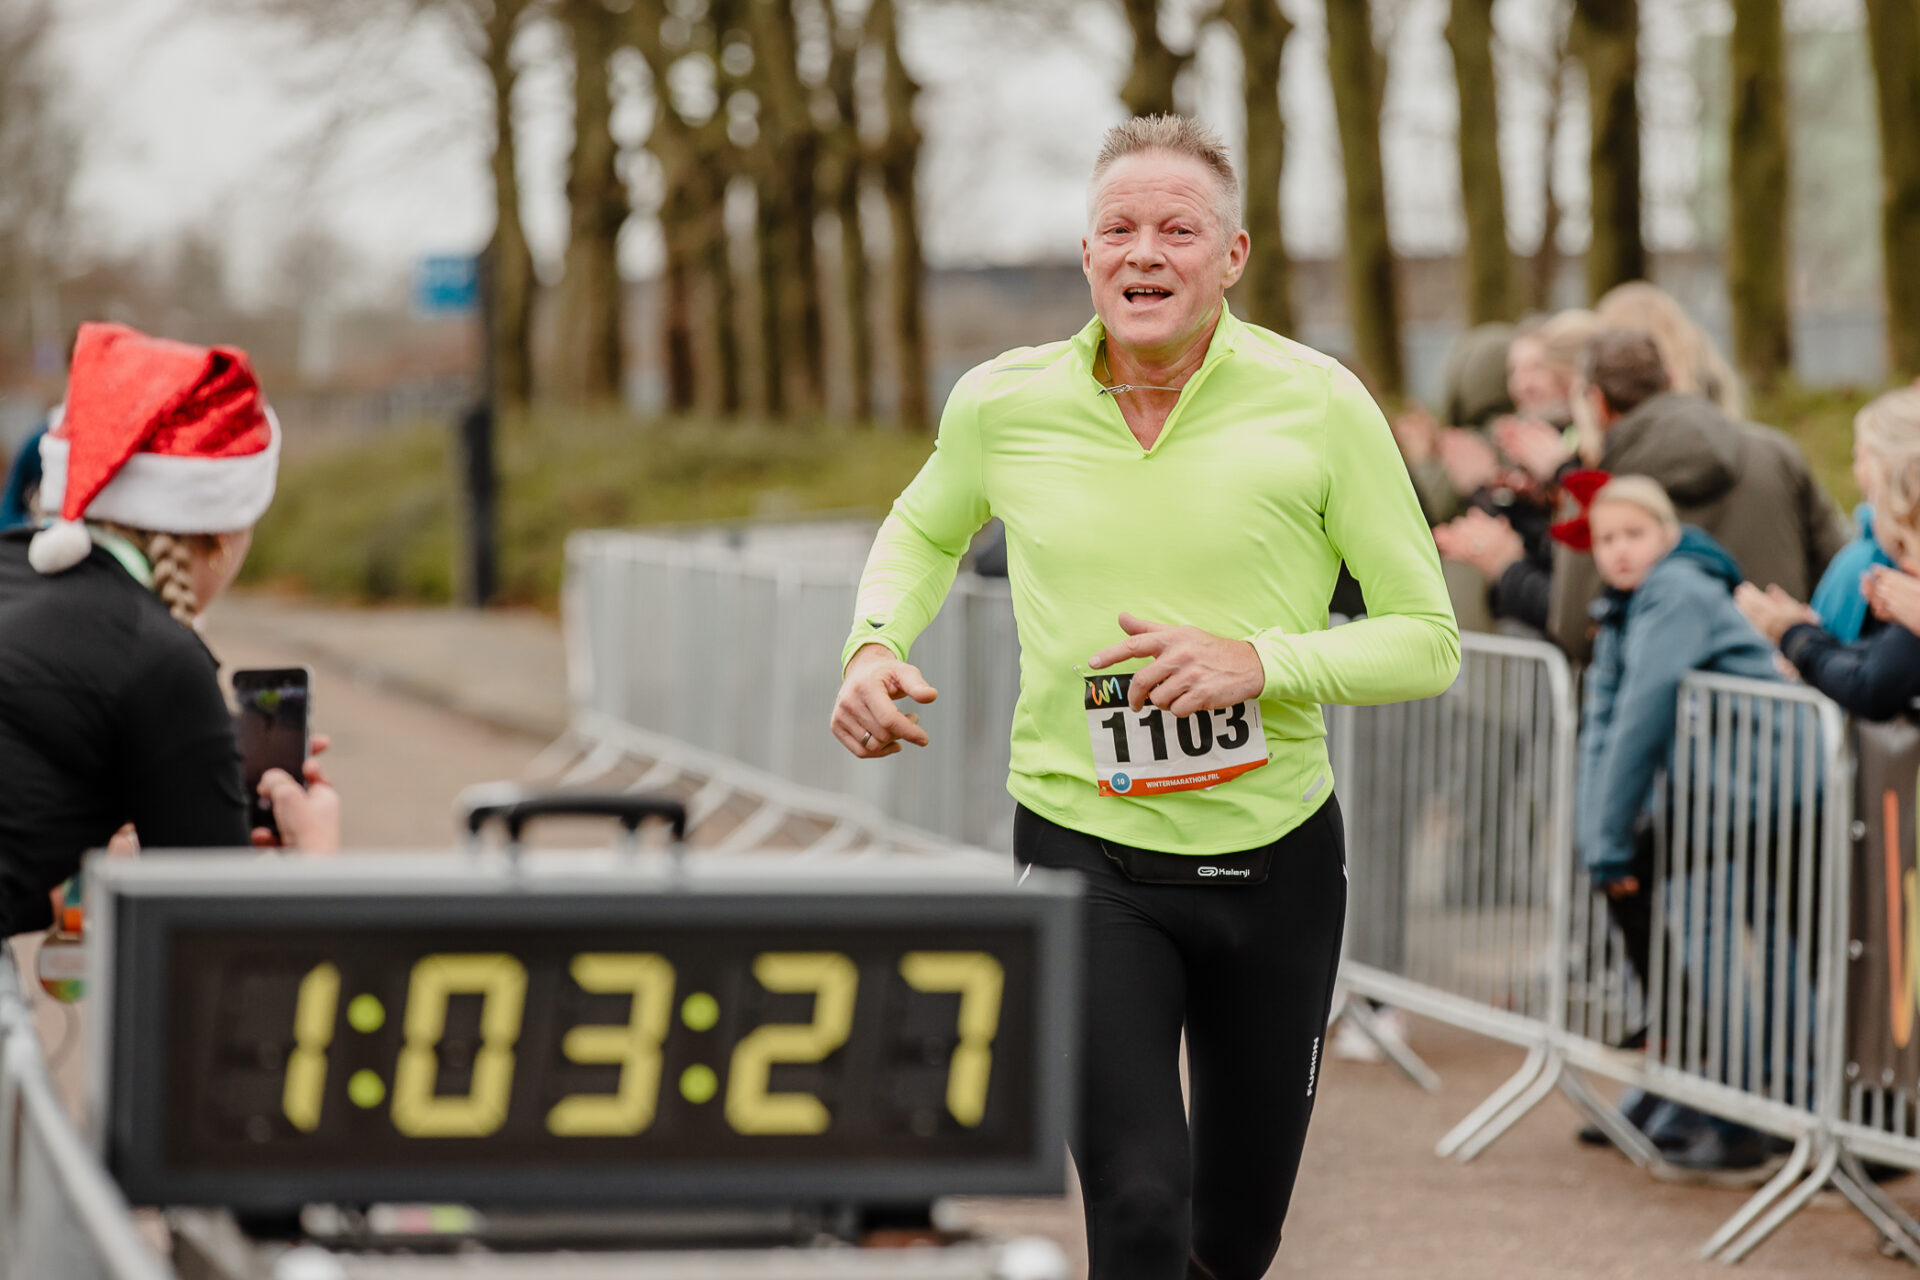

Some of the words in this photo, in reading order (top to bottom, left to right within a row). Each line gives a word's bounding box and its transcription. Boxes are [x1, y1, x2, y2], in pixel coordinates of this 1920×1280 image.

[1101, 700, 1250, 763] 1103
[1115, 777, 1126, 787] 10
[1145, 773, 1220, 789] WINTERMARATHON.FRL
[282, 951, 1005, 1138] 1:03:27
[1306, 1036, 1320, 1096] FUSION
